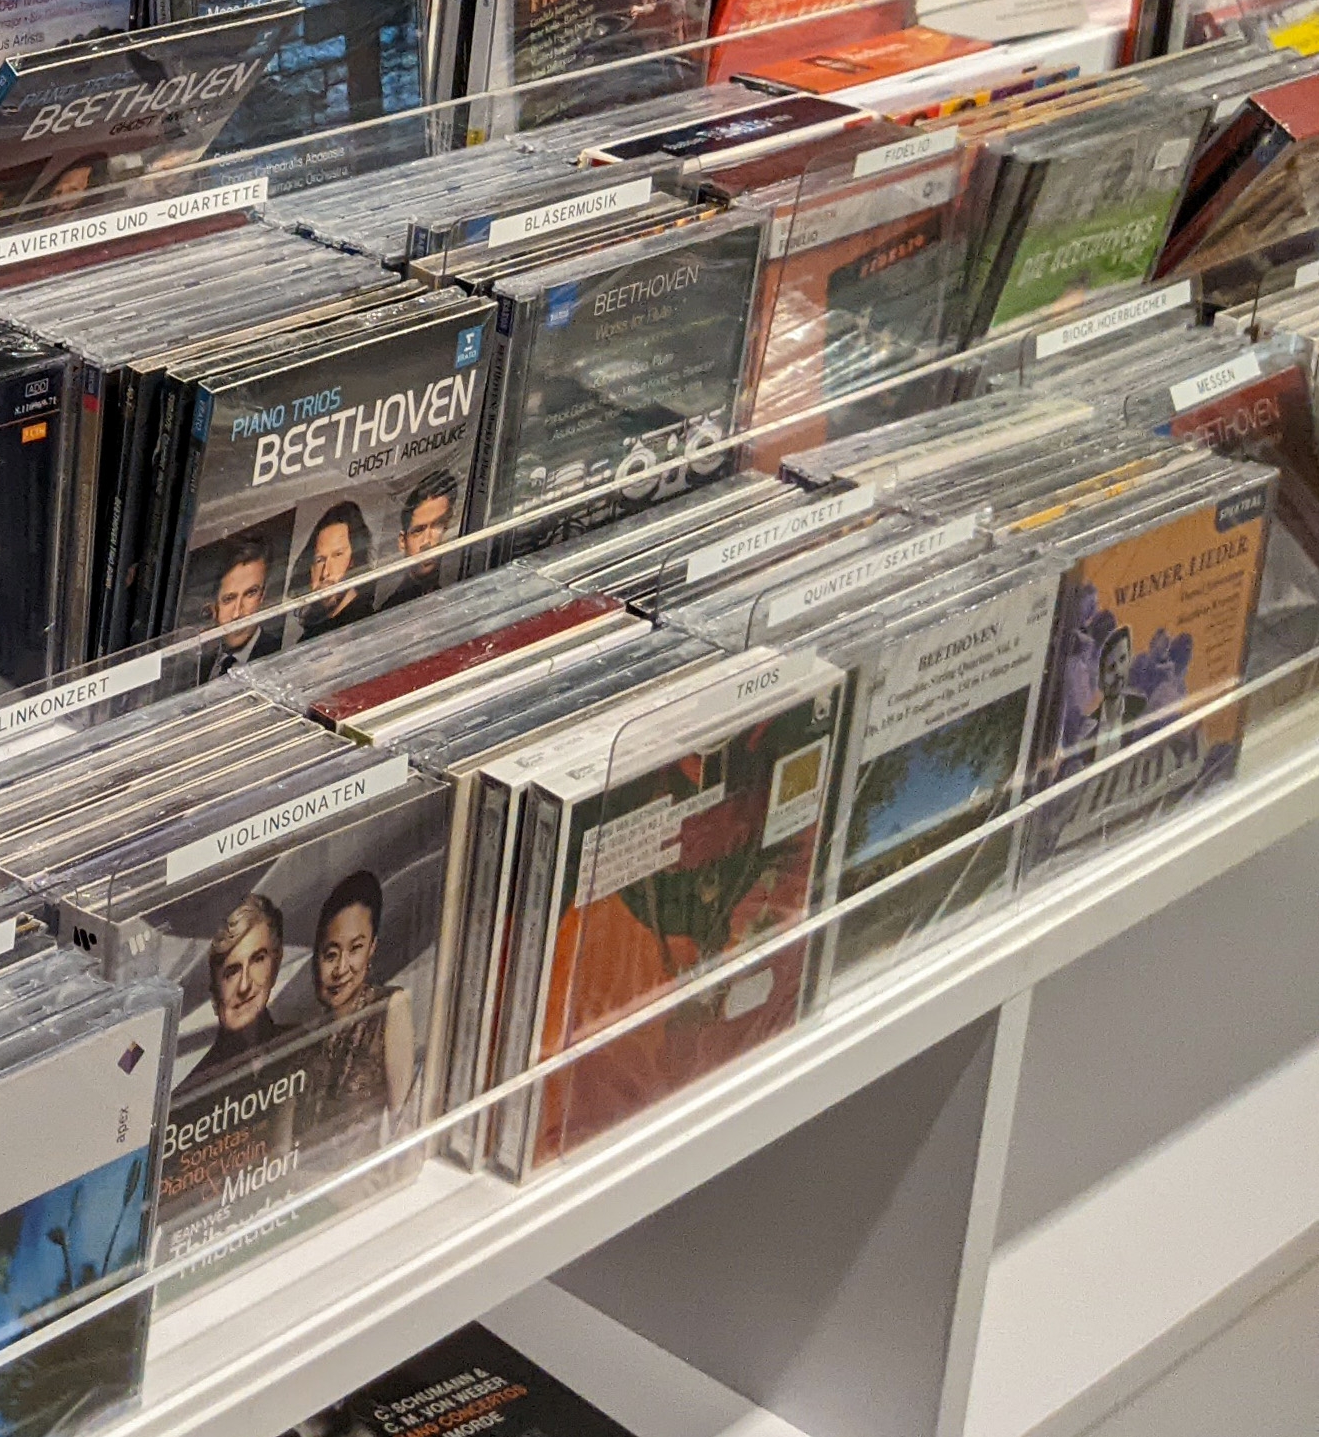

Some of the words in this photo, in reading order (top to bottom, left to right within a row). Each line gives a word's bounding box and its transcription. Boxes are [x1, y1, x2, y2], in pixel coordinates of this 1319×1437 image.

[13, 32, 44, 46] Artists
[21, 59, 261, 142] BEETHOVEN
[884, 138, 931, 162] FIDELIO
[115, 211, 149, 231] UND
[156, 182, 262, 219] -QUARTETTE
[524, 193, 617, 233] BLÄSERMUSIK
[593, 265, 700, 317] BEETHOVEN
[1197, 370, 1236, 394] MESSEN
[232, 405, 285, 442] PIANO
[292, 387, 342, 418] TRIOS
[250, 370, 477, 486] BEETHOVEN
[347, 450, 393, 479] GHOST
[401, 426, 467, 461] ARCHDUKE
[1114, 561, 1185, 606] WIENER
[1189, 537, 1248, 578] LIEDER
[736, 668, 780, 697] TRIOS
[217, 779, 366, 855] VIOLINSONATEN
[162, 1069, 306, 1160] Beethoven
[221, 1141, 300, 1207] Midori
[375, 1408, 391, 1422] C.
[395, 1373, 471, 1414] SCHUMANN
[384, 1419, 401, 1434] C.
[403, 1412, 420, 1427] M.
[422, 1399, 453, 1419] VON
[453, 1376, 507, 1405] WEBER
[439, 1386, 528, 1428] CONCERTOS
